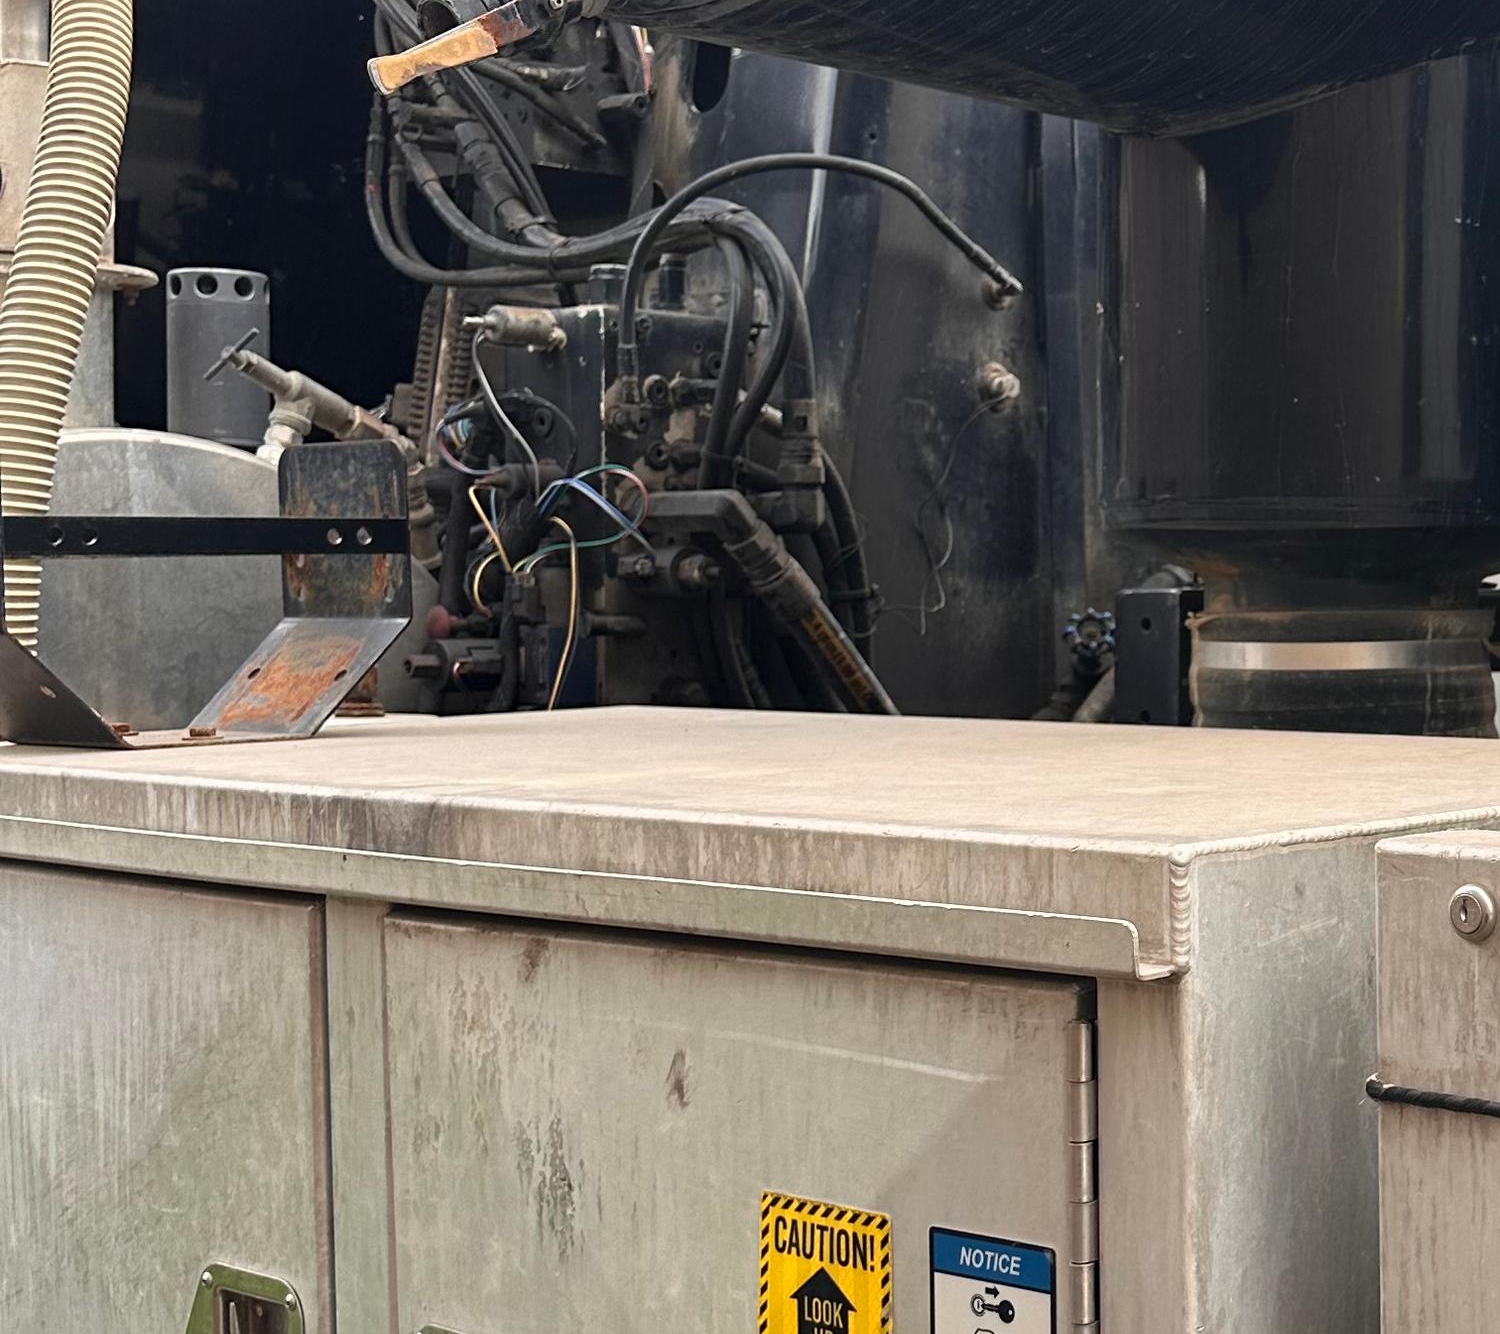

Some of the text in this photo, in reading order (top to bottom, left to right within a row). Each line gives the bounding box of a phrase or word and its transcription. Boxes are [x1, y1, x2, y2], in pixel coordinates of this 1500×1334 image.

[774, 1215, 875, 1272] CAUTION!
[960, 1246, 1021, 1275] NOTICE
[804, 1296, 843, 1329] LOOK
